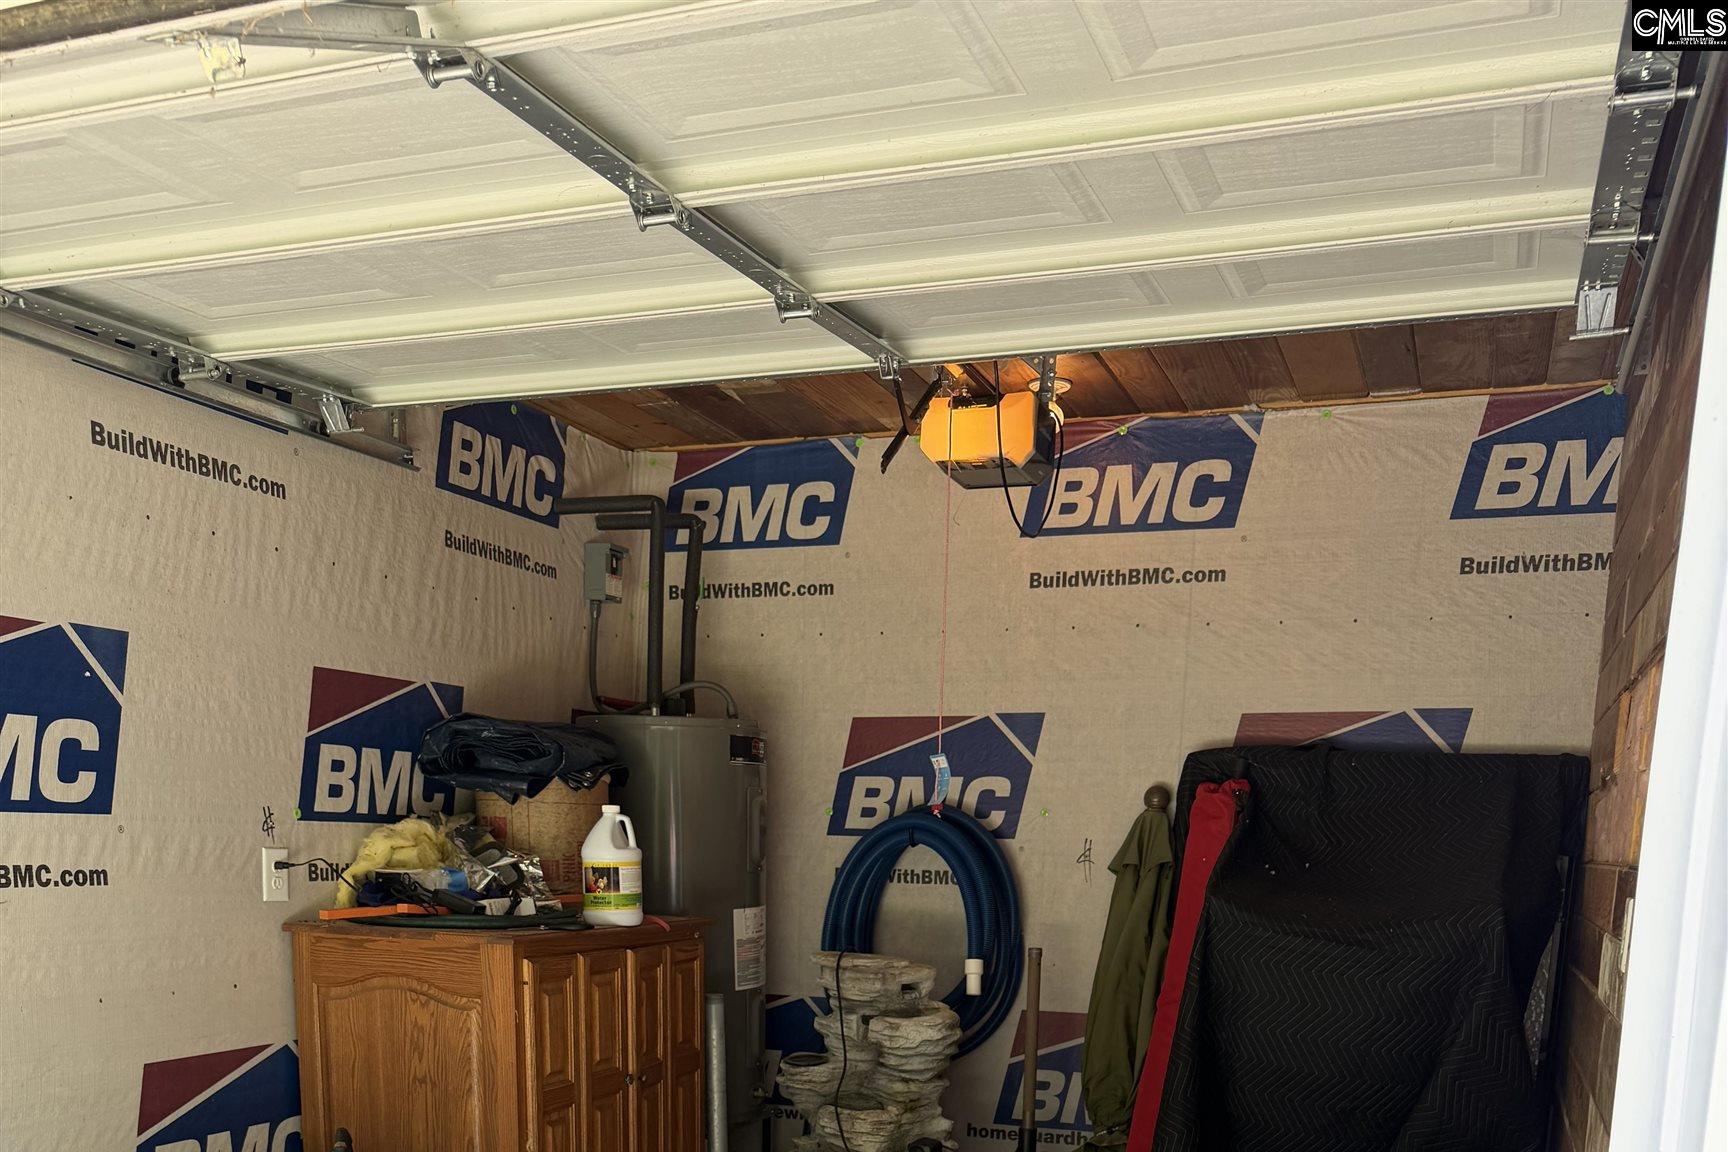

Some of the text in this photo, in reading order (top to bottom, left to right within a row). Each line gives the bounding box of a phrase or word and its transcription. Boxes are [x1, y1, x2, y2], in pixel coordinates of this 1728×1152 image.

[90, 420, 287, 500] BuildWithBMC.com
[448, 421, 557, 517] BMC
[1042, 458, 1233, 529] BMC
[675, 481, 836, 545] BMC
[445, 529, 557, 580] BuildWithBMC.com
[1029, 567, 1227, 589] BuildWithBMC.com
[669, 581, 835, 600] BdWithBMC.com
[313, 743, 446, 817] BMC
